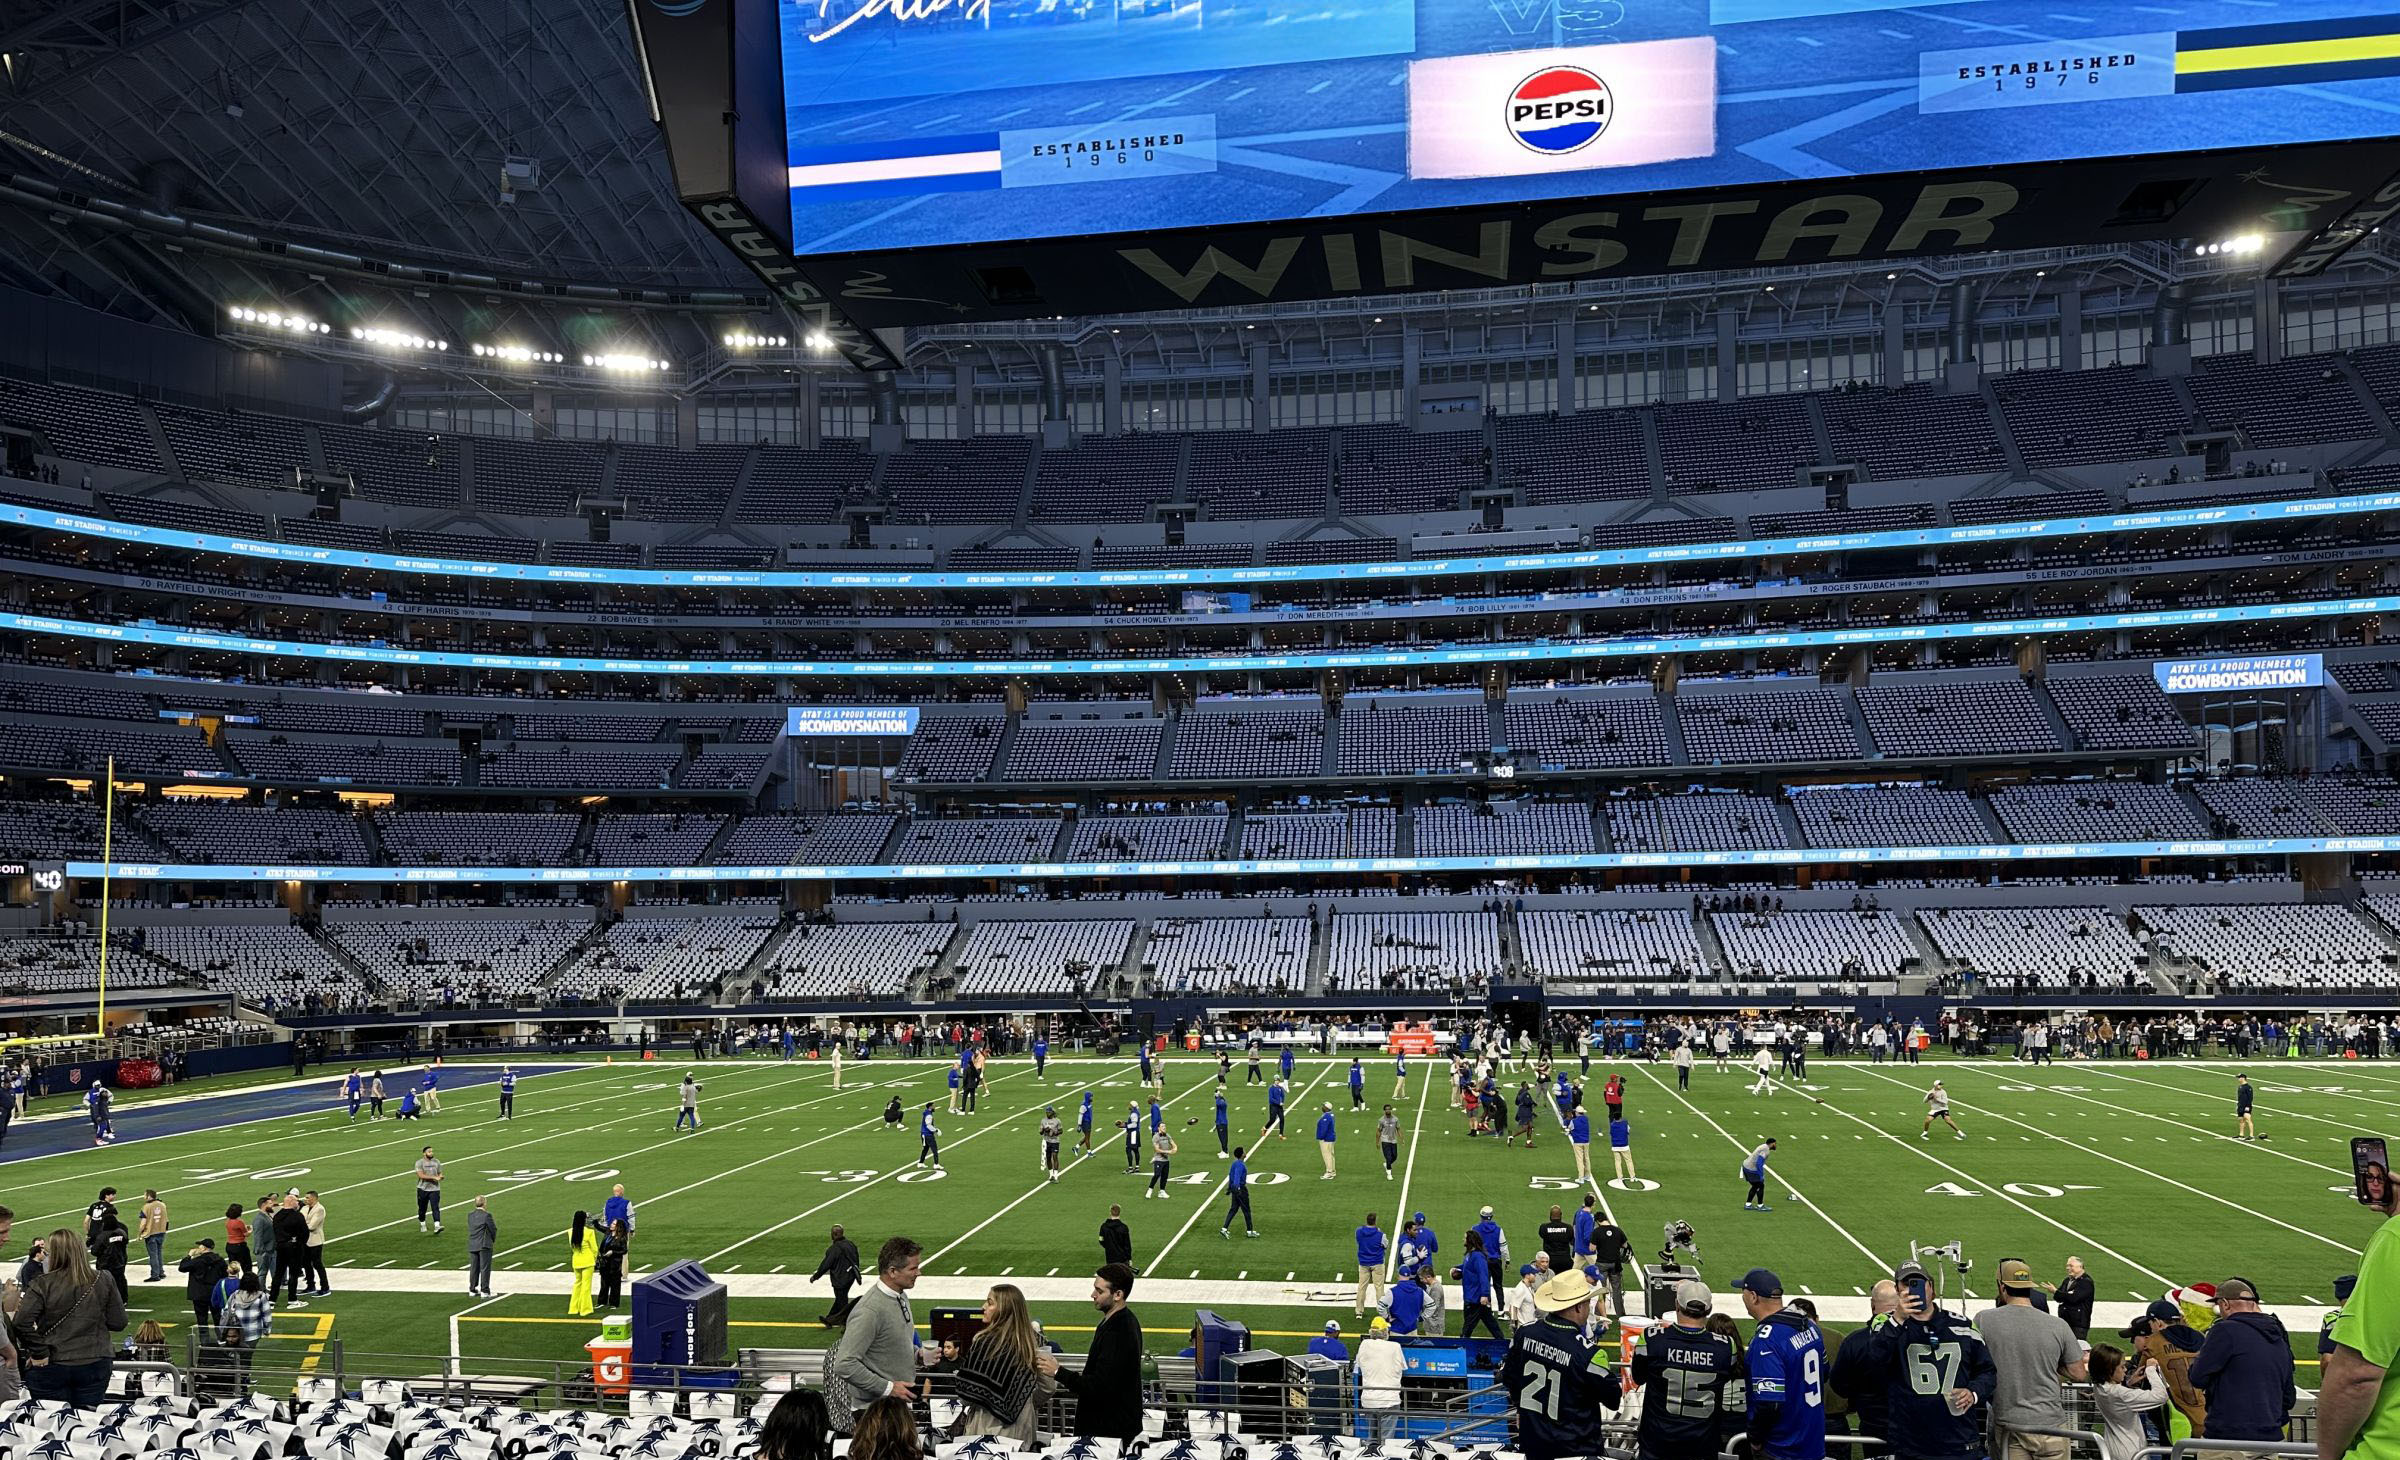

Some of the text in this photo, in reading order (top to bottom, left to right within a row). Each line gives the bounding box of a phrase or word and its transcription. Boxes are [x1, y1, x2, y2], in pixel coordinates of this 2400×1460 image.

[1959, 54, 2135, 79] ESTABLISHED
[1514, 99, 1604, 122] PEPSI
[1033, 133, 1185, 156] ESTABLISHED
[1116, 180, 2020, 302] WINSTAR
[2285, 504, 2303, 513] AT&T
[2305, 501, 2336, 511] STADIUM
[55, 516, 73, 526] AT&T
[75, 520, 106, 532] STADIUM
[2113, 518, 2130, 527] AT&T
[2131, 516, 2160, 525] STADIUM
[1951, 530, 1967, 539] AT&T
[1968, 528, 1996, 537] STADIUM
[231, 541, 248, 551] AT&T
[249, 544, 279, 555] STADIUM
[1796, 539, 1840, 549] AT&T STADIUM
[2278, 554, 2300, 562] TOM
[2304, 551, 2345, 560] LANDRY
[395, 559, 440, 570] AT&T STADIUM
[2080, 568, 2117, 576] JORDAN
[140, 579, 151, 588] 70
[156, 580, 205, 594] RAYFIELD
[208, 585, 247, 598] WRIGHT
[1853, 582, 1896, 590] STAUBACH
[1634, 596, 1650, 604] DON
[1654, 594, 1686, 602] PERKINS
[398, 604, 422, 614] CLIFF
[426, 606, 460, 616] HARRIS
[1487, 604, 1506, 612] LILLY
[588, 615, 596, 623] 22
[601, 615, 620, 624] BOB
[622, 616, 648, 624] HAYES
[762, 618, 772, 626] 54
[776, 618, 803, 626] RANDY
[806, 618, 831, 626] WHITE
[1142, 616, 1172, 624] HOWLEY
[2170, 658, 2307, 674] AT&T IS A PROUD MEMBER OF
[2167, 669, 2307, 689] #COWBOYSNATION
[800, 710, 908, 718] AT&T IS A PROUD MEMBER OF
[799, 720, 907, 733] #COWBOYSNATION
[1494, 766, 1514, 778] 9:08
[2169, 844, 2225, 852] AT&T STADIUM
[2325, 840, 2384, 849] AT&T STADIUM
[1752, 852, 1802, 861] AT&T STADIUM
[1890, 848, 1940, 858] AT&T STADIUM
[2023, 847, 2076, 855] AT&T STADIUM
[0, 864, 24, 874] om
[265, 869, 318, 878] AT&T STADIUM
[407, 870, 425, 878] AT&T
[35, 870, 62, 890] 40
[1758, 1324, 1772, 1338] 9
[1790, 1329, 1814, 1350] WALKER
[1522, 1336, 1572, 1366] WITHERSPOON
[1668, 1348, 1714, 1366] KEARSE
[600, 1356, 623, 1382] G
[1906, 1342, 1962, 1395] 67
[1804, 1348, 1822, 1408] 9
[1520, 1360, 1562, 1420] 21
[1662, 1368, 1718, 1419] 15
